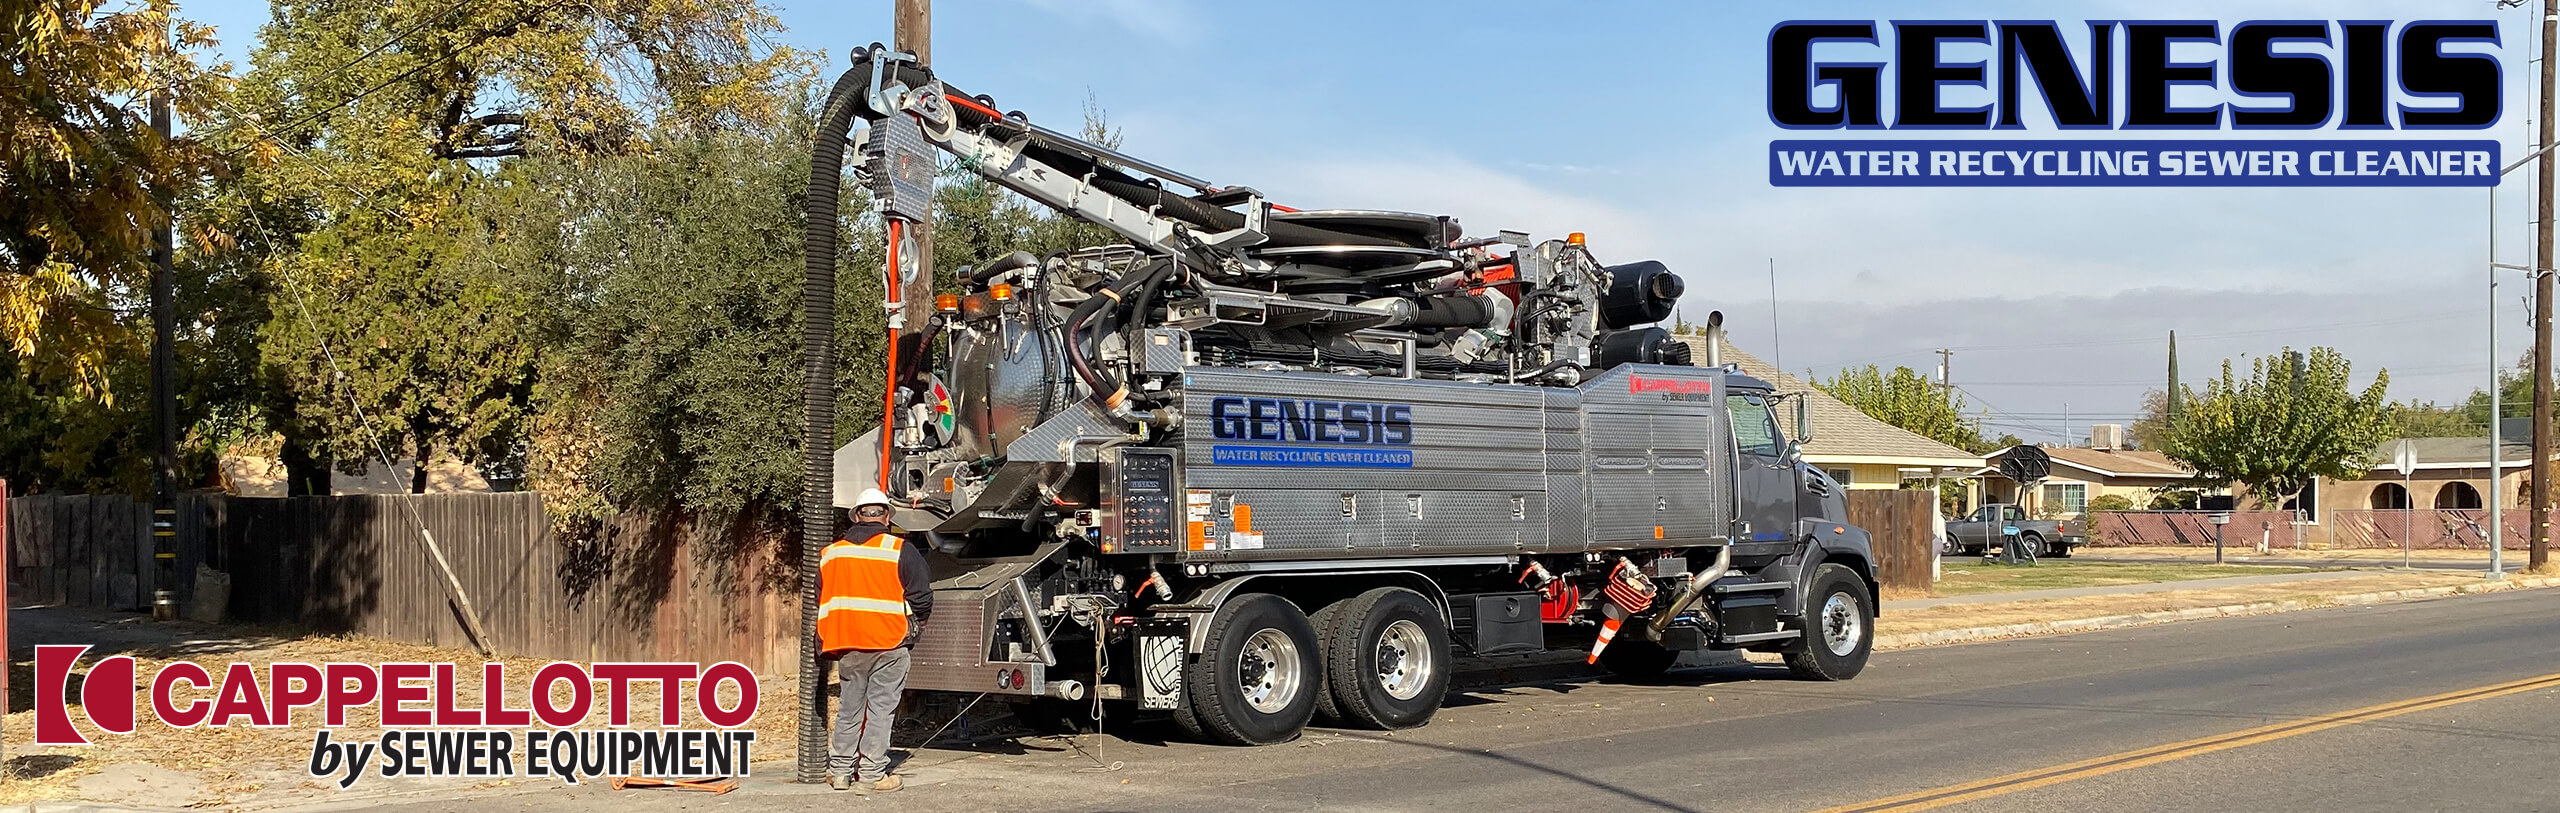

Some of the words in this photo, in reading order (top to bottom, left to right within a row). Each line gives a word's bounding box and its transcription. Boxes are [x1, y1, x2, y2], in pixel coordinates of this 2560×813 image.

[1212, 397, 1412, 445] GENESIS
[1216, 449, 1258, 461] WATER
[1260, 450, 1322, 463] RECYCLING
[1324, 452, 1361, 463] SEWER
[1363, 453, 1410, 464] CLEANER
[1144, 696, 1174, 709] SEWER
